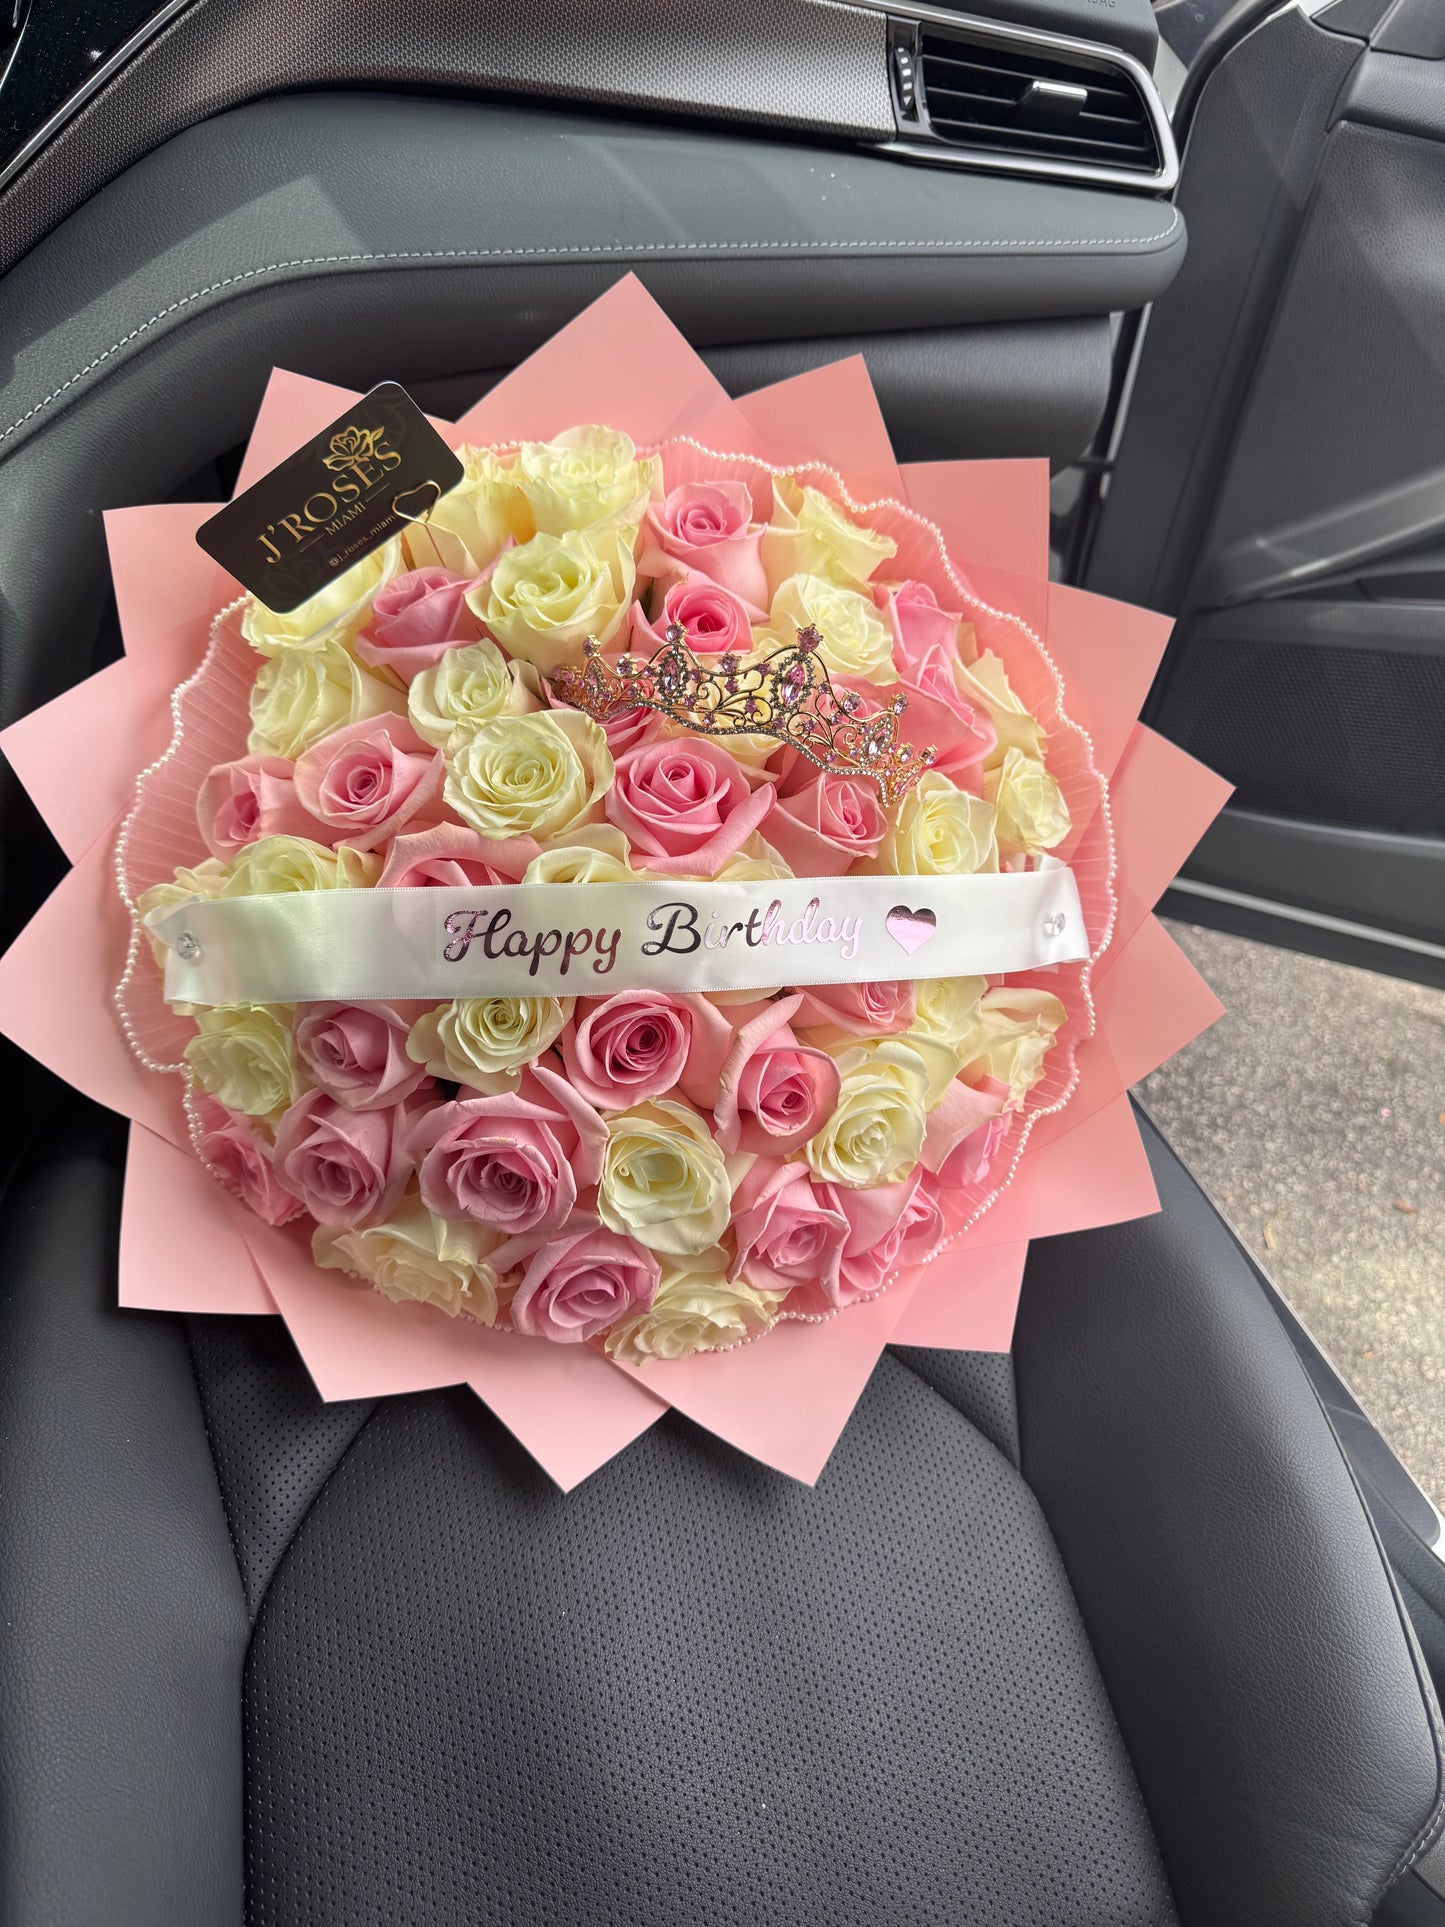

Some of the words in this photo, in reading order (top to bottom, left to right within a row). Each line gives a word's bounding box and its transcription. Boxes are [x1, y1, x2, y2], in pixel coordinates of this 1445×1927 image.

[256, 440, 402, 565] J'ROSES
[324, 501, 367, 536] MIAMI
[443, 909, 622, 976] Happy
[641, 896, 863, 960] Birthday
